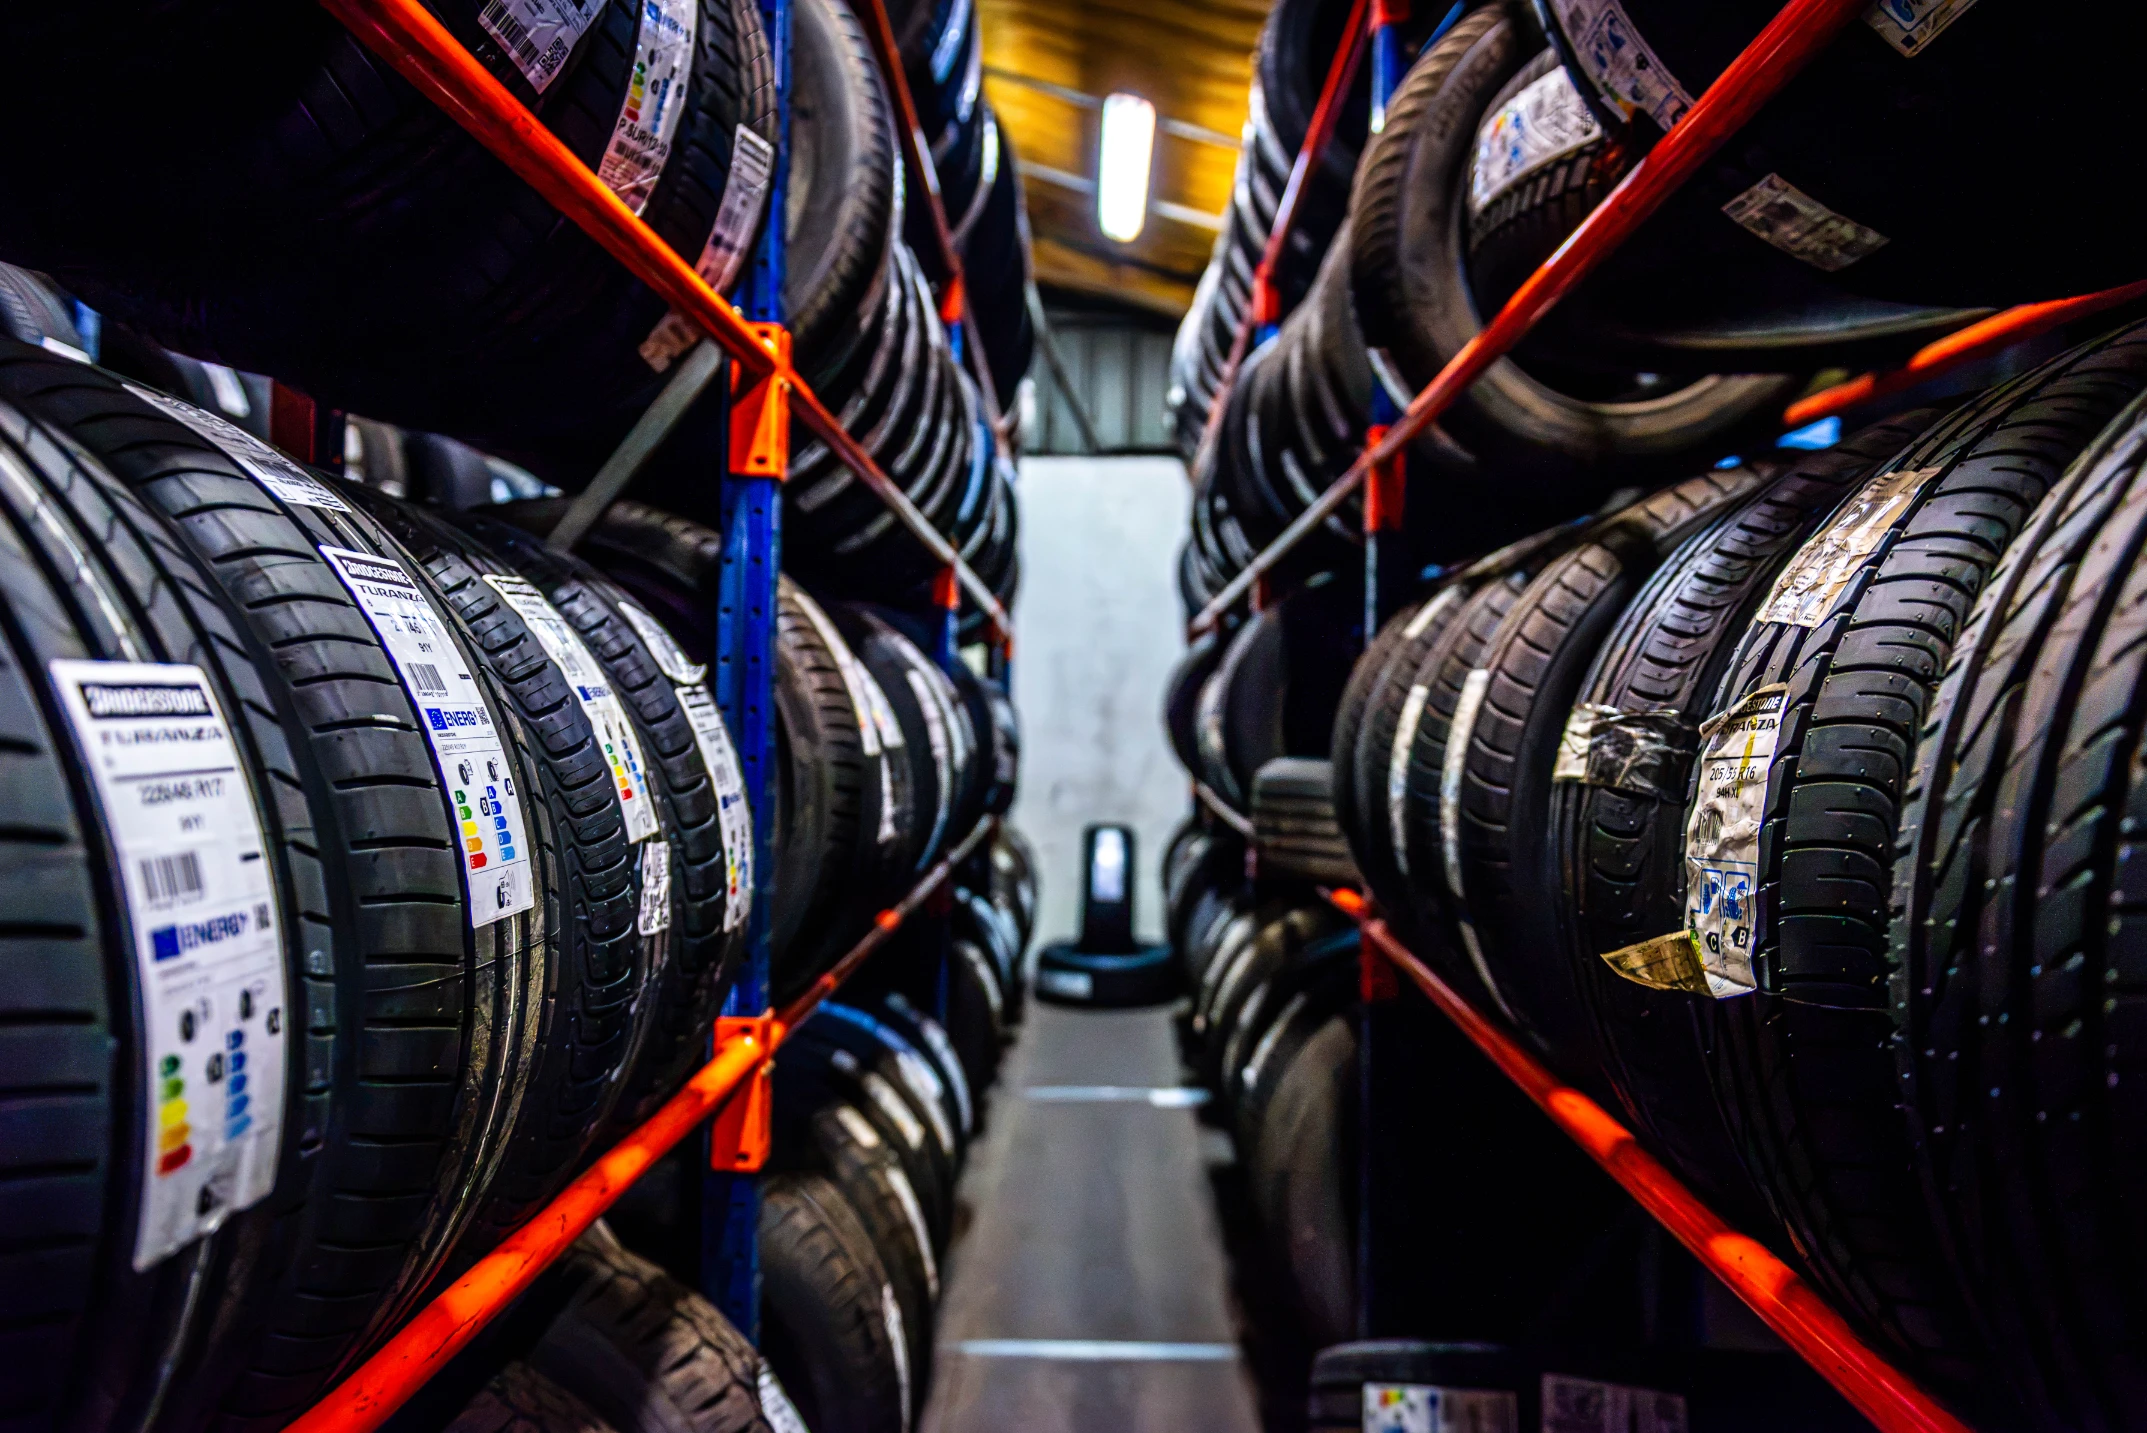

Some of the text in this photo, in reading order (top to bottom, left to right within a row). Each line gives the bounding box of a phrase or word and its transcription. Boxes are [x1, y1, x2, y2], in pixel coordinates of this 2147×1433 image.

[345, 559, 412, 585] BRIDGESTONE
[356, 583, 426, 603] TURANZA
[99, 726, 225, 747] TURANZA
[1710, 766, 1757, 784] 205/55 R16
[1716, 787, 1729, 798] 94H
[1710, 934, 1717, 951] C
[1738, 930, 1746, 946] B
